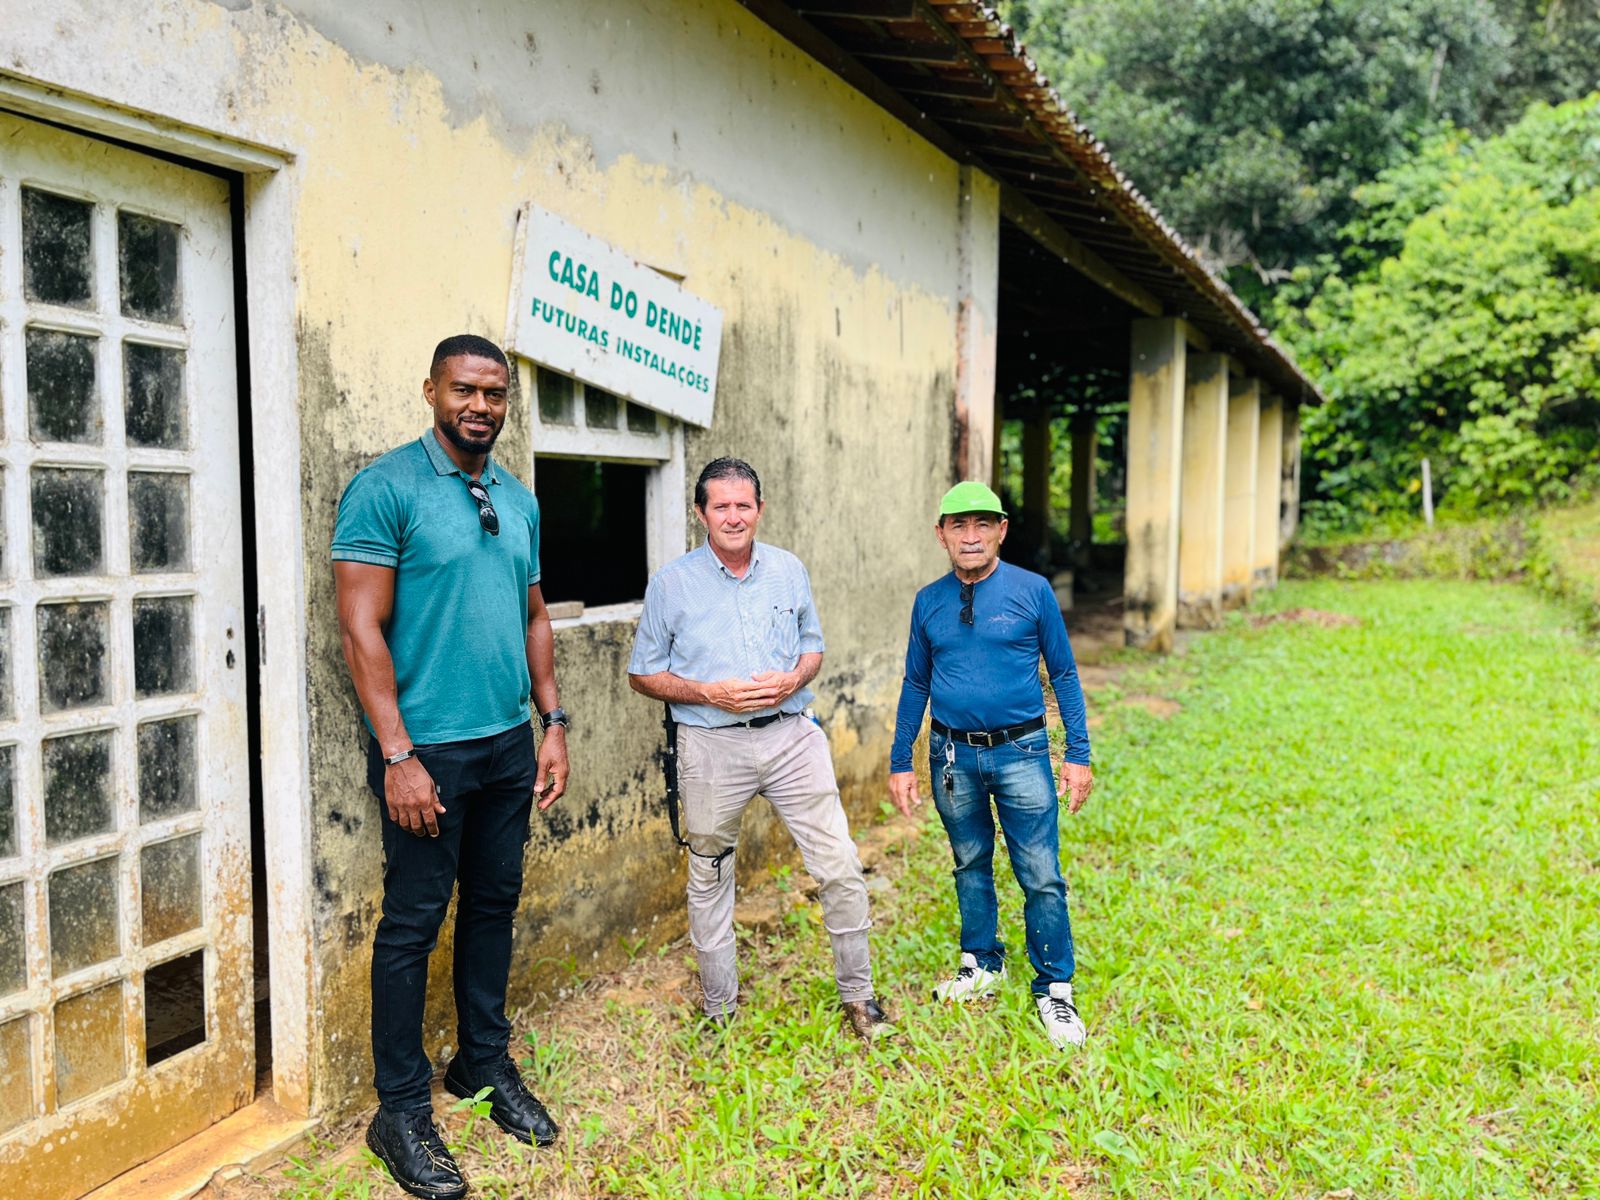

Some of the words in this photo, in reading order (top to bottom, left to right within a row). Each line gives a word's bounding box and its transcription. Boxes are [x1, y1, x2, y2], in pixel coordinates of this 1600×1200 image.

[548, 250, 600, 302] CASA
[609, 281, 639, 320] DO
[531, 297, 609, 348] FUTURAS
